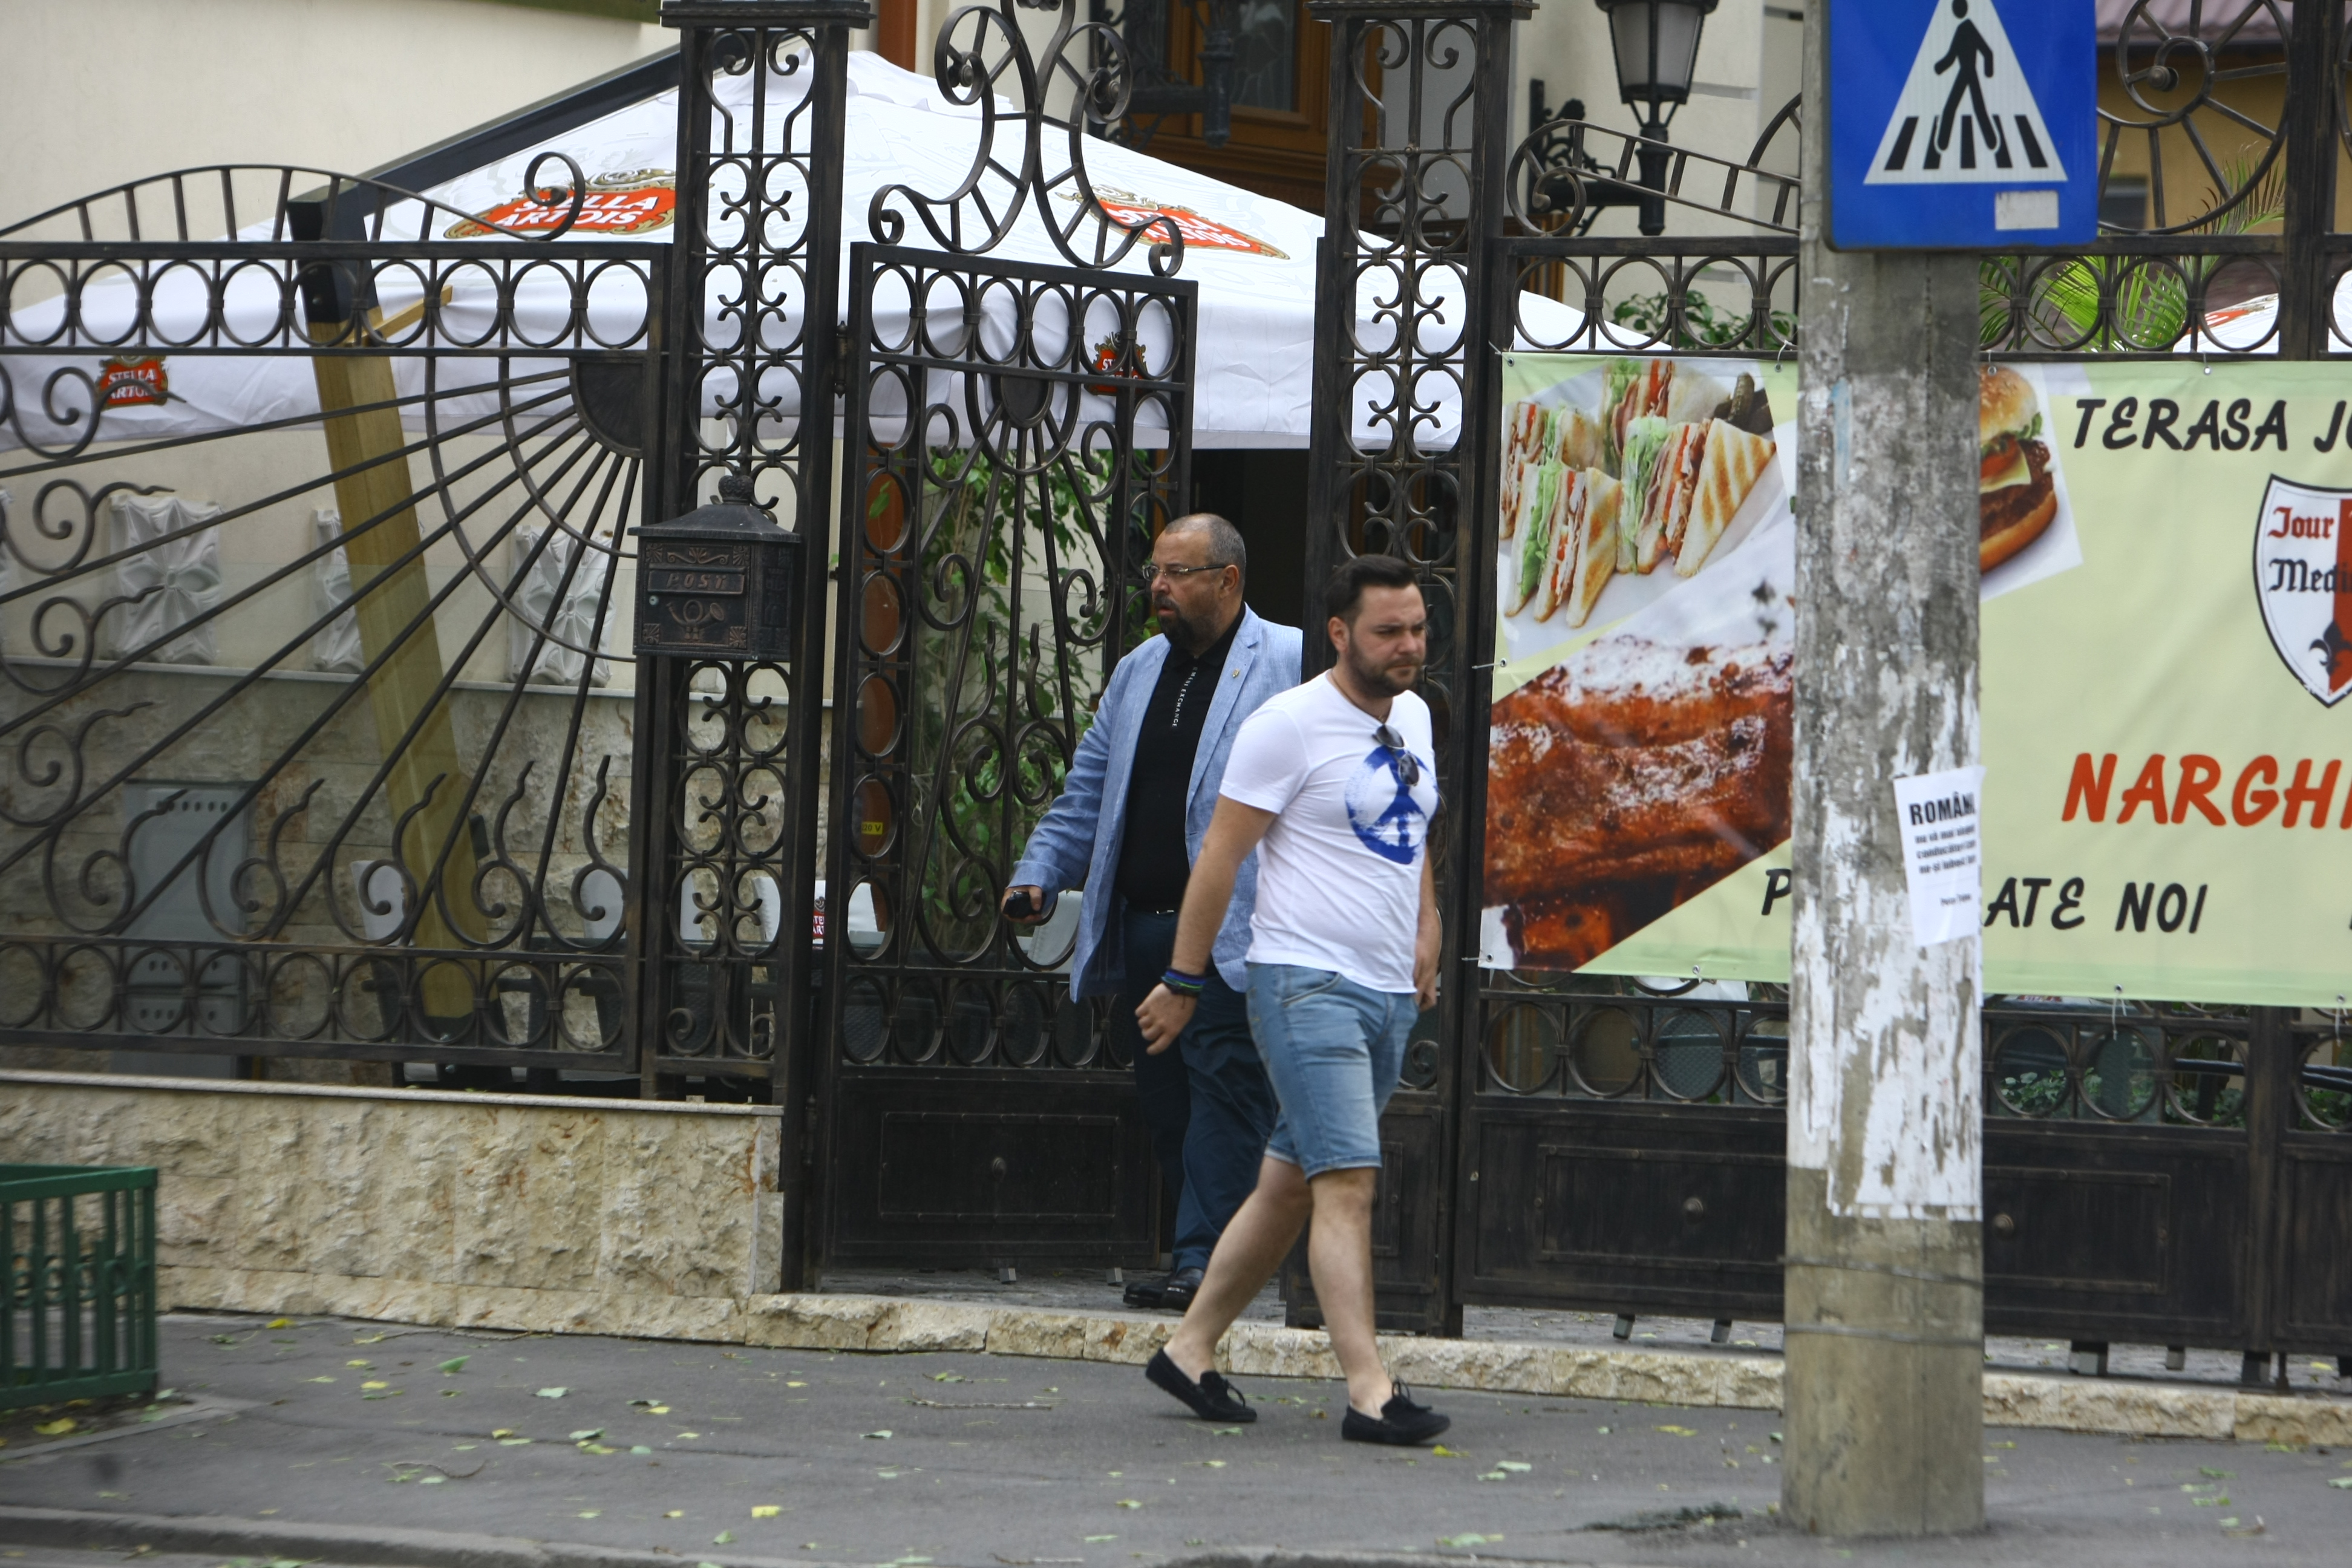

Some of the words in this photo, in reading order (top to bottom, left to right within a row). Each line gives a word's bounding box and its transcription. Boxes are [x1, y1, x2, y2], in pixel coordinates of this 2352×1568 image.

[514, 194, 659, 213] SELLA
[2074, 396, 2288, 452] TERASA
[2313, 400, 2352, 453] J
[2267, 505, 2336, 540] Jour
[666, 572, 727, 589] POST
[2269, 557, 2352, 593] Medi
[1172, 688, 1187, 727] EXCHANGE
[2115, 881, 2208, 933] NOI
